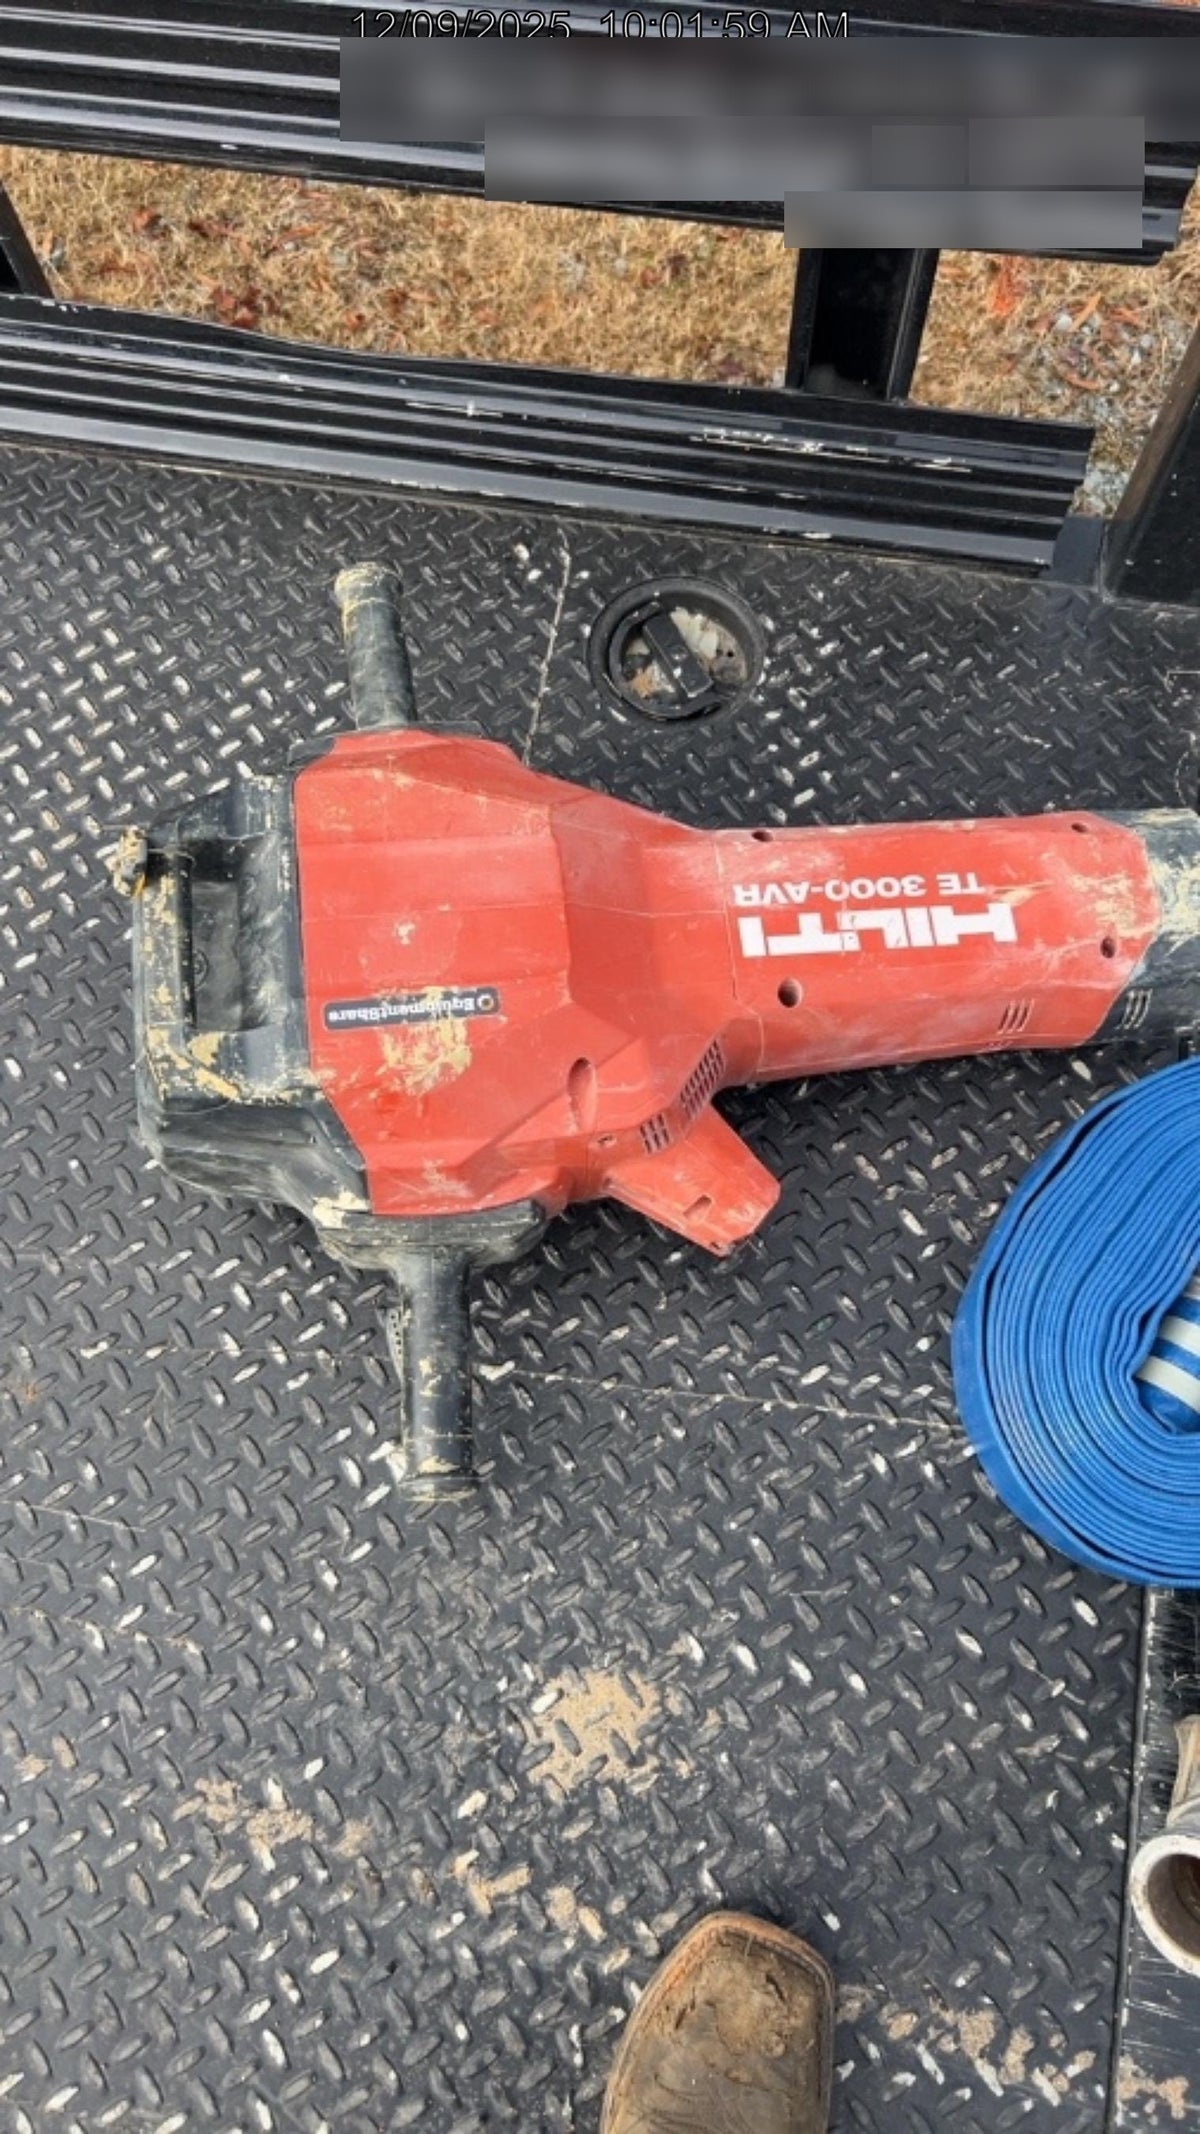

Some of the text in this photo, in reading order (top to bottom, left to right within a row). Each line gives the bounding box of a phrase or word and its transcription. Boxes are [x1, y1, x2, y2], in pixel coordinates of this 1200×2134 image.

[733, 872, 987, 907] TE 3000-AVR
[737, 902, 1018, 957] HILTI
[328, 996, 476, 1022] EquipmentShare
